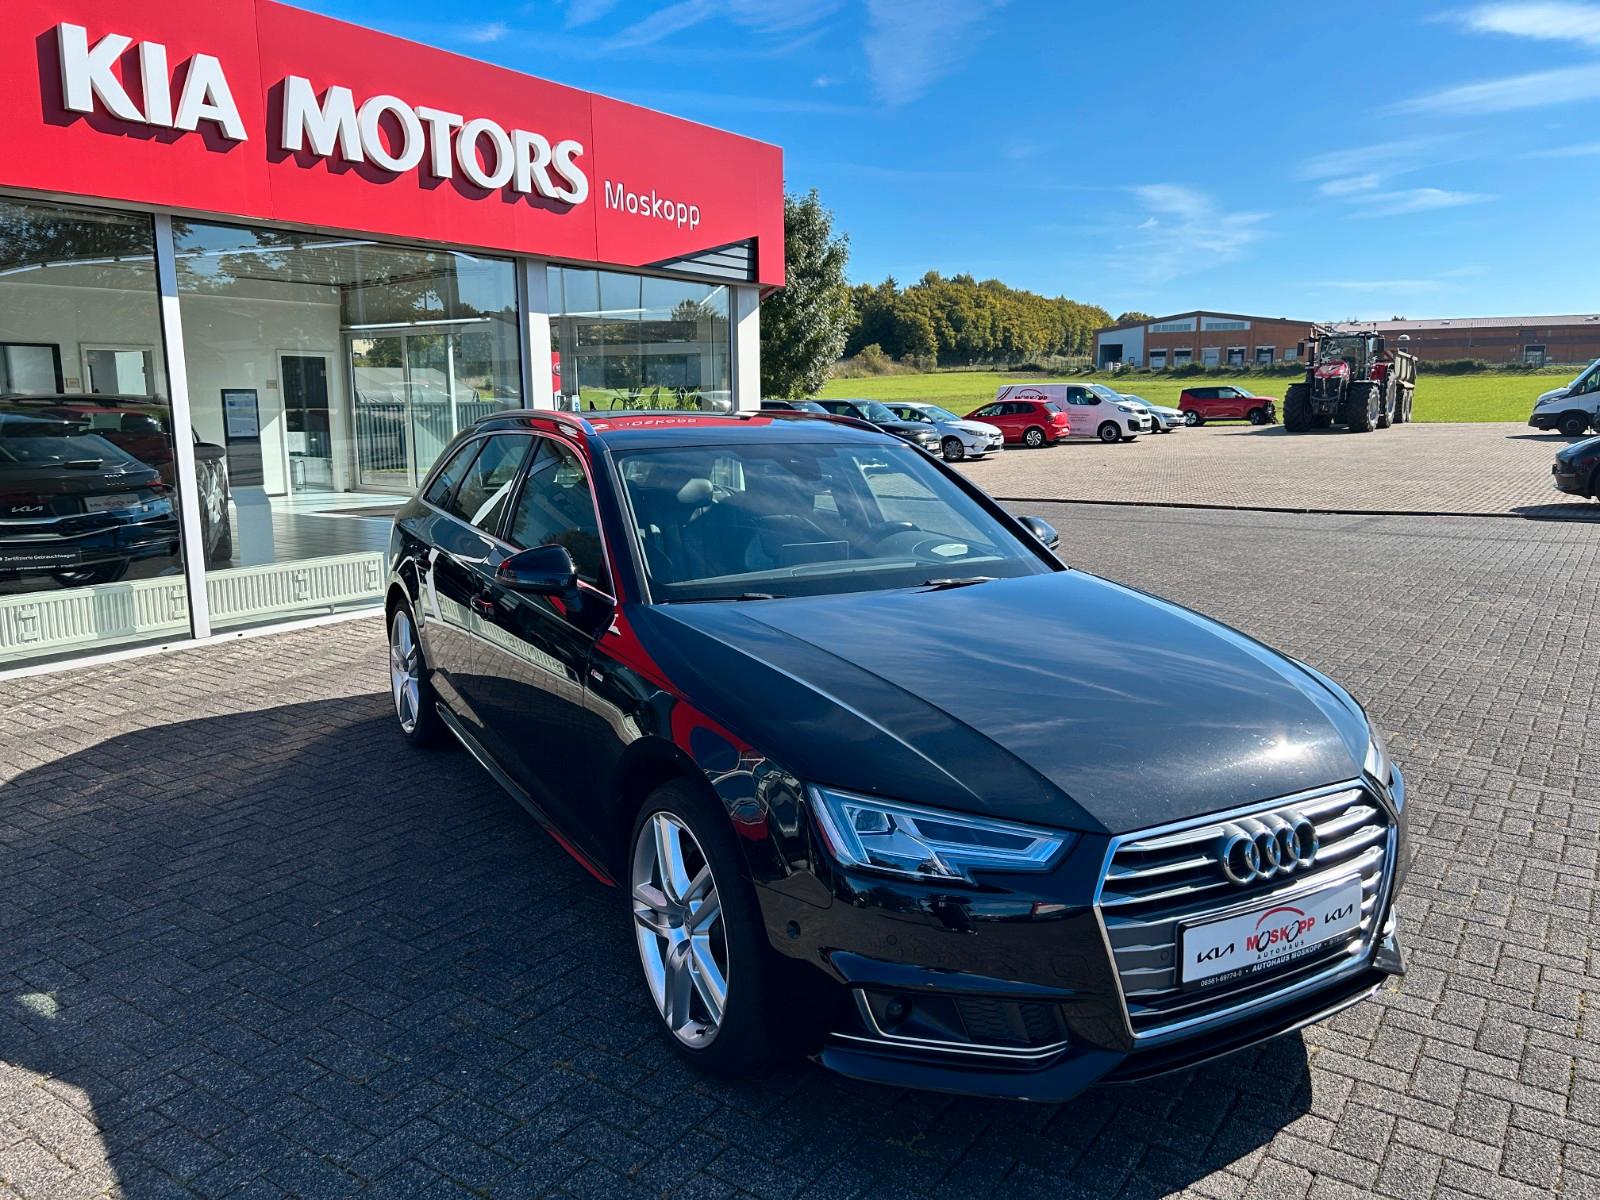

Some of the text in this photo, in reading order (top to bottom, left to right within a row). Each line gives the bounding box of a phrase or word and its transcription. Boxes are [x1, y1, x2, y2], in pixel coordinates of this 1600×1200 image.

[57, 22, 589, 205] KIA MOTORS
[603, 180, 701, 230] Moskopp
[1325, 903, 1353, 924] KIA
[1246, 916, 1316, 952] MOSKOPP
[1197, 942, 1235, 964] KIA
[1252, 953, 1290, 972] AUTOHAUS
[1291, 943, 1322, 961] MOSKOPP
[1257, 939, 1305, 960] AUTOHAUS
